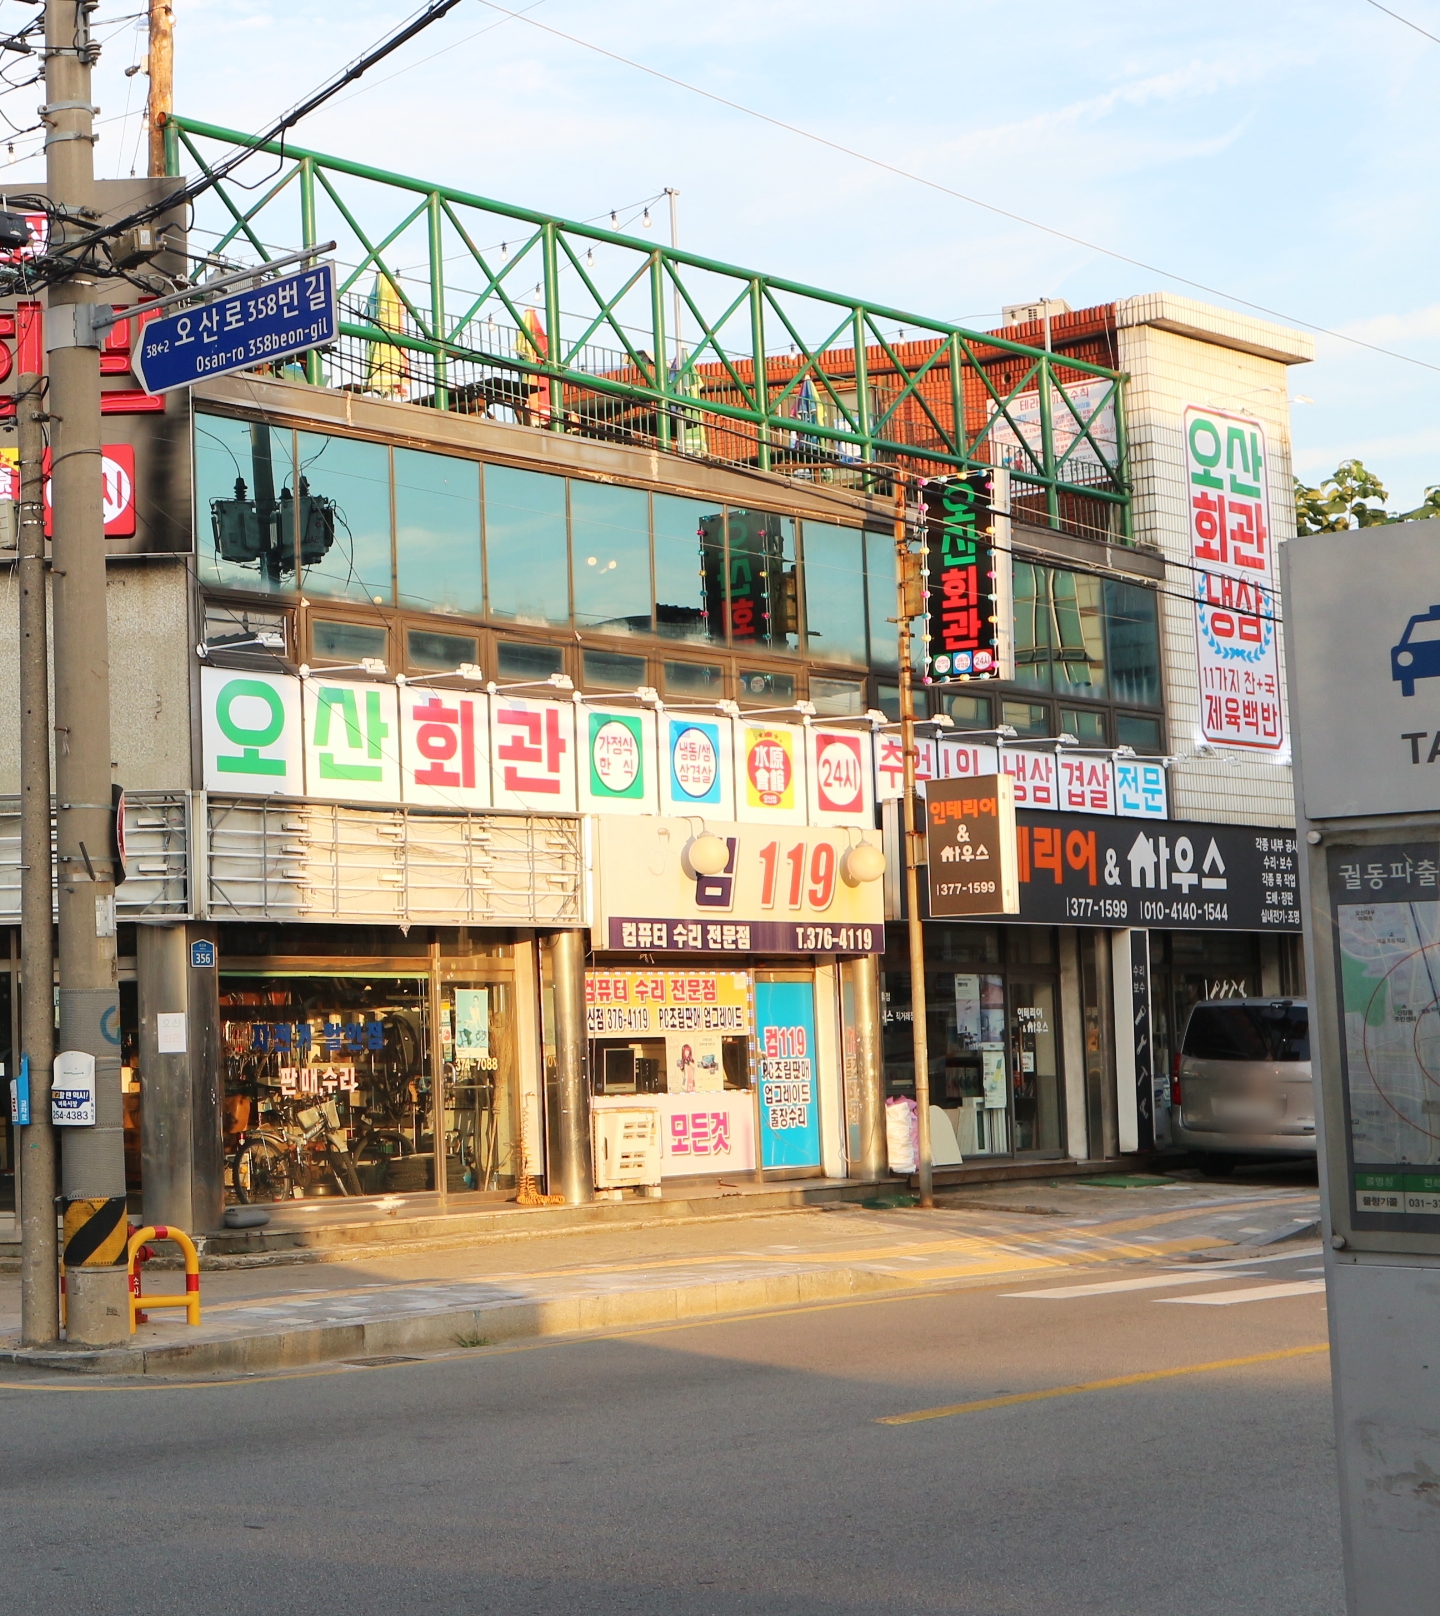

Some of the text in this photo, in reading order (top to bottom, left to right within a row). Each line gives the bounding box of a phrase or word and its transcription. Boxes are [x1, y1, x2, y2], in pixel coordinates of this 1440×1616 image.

[196, 318, 328, 373] Osan-ro 358beon-gil
[1188, 417, 1263, 499] 오산
[1191, 491, 1267, 571] 회관
[1205, 572, 1264, 643] 냉삼
[1203, 666, 1276, 698] 11가지 찬+국
[1205, 694, 1278, 738] 제육백반
[215, 678, 567, 795] 오산회관
[598, 734, 633, 755] 가정식
[678, 741, 711, 762] 냉동/생
[754, 745, 785, 770] 水原
[679, 763, 712, 784] 삼겹살
[822, 758, 858, 792] 24시
[1117, 765, 1162, 811] 전문
[929, 798, 997, 825] 인테리어
[956, 824, 971, 842] &
[759, 840, 837, 911] 119
[1104, 847, 1122, 887] &
[621, 922, 873, 951] 컴퓨터 수리 전문점 T.376-4119
[195, 953, 211, 964] 356
[1133, 965, 1145, 977] 수리
[635, 978, 665, 1002] 수리
[671, 978, 717, 1001] 전문점
[1133, 983, 1146, 994] 보수
[607, 1007, 649, 1030] 376-4119
[659, 1007, 701, 1029] PC조립판매
[704, 1006, 743, 1029] 업그레이드
[1017, 1007, 1043, 1021] 인테리어
[765, 1027, 806, 1058] 컴119
[455, 1057, 499, 1071] 374-7088
[762, 1061, 810, 1080] PC조립판매
[765, 1084, 810, 1105] 업그레이드
[771, 1107, 806, 1128] 출장수리
[671, 1112, 731, 1154] 모든것
